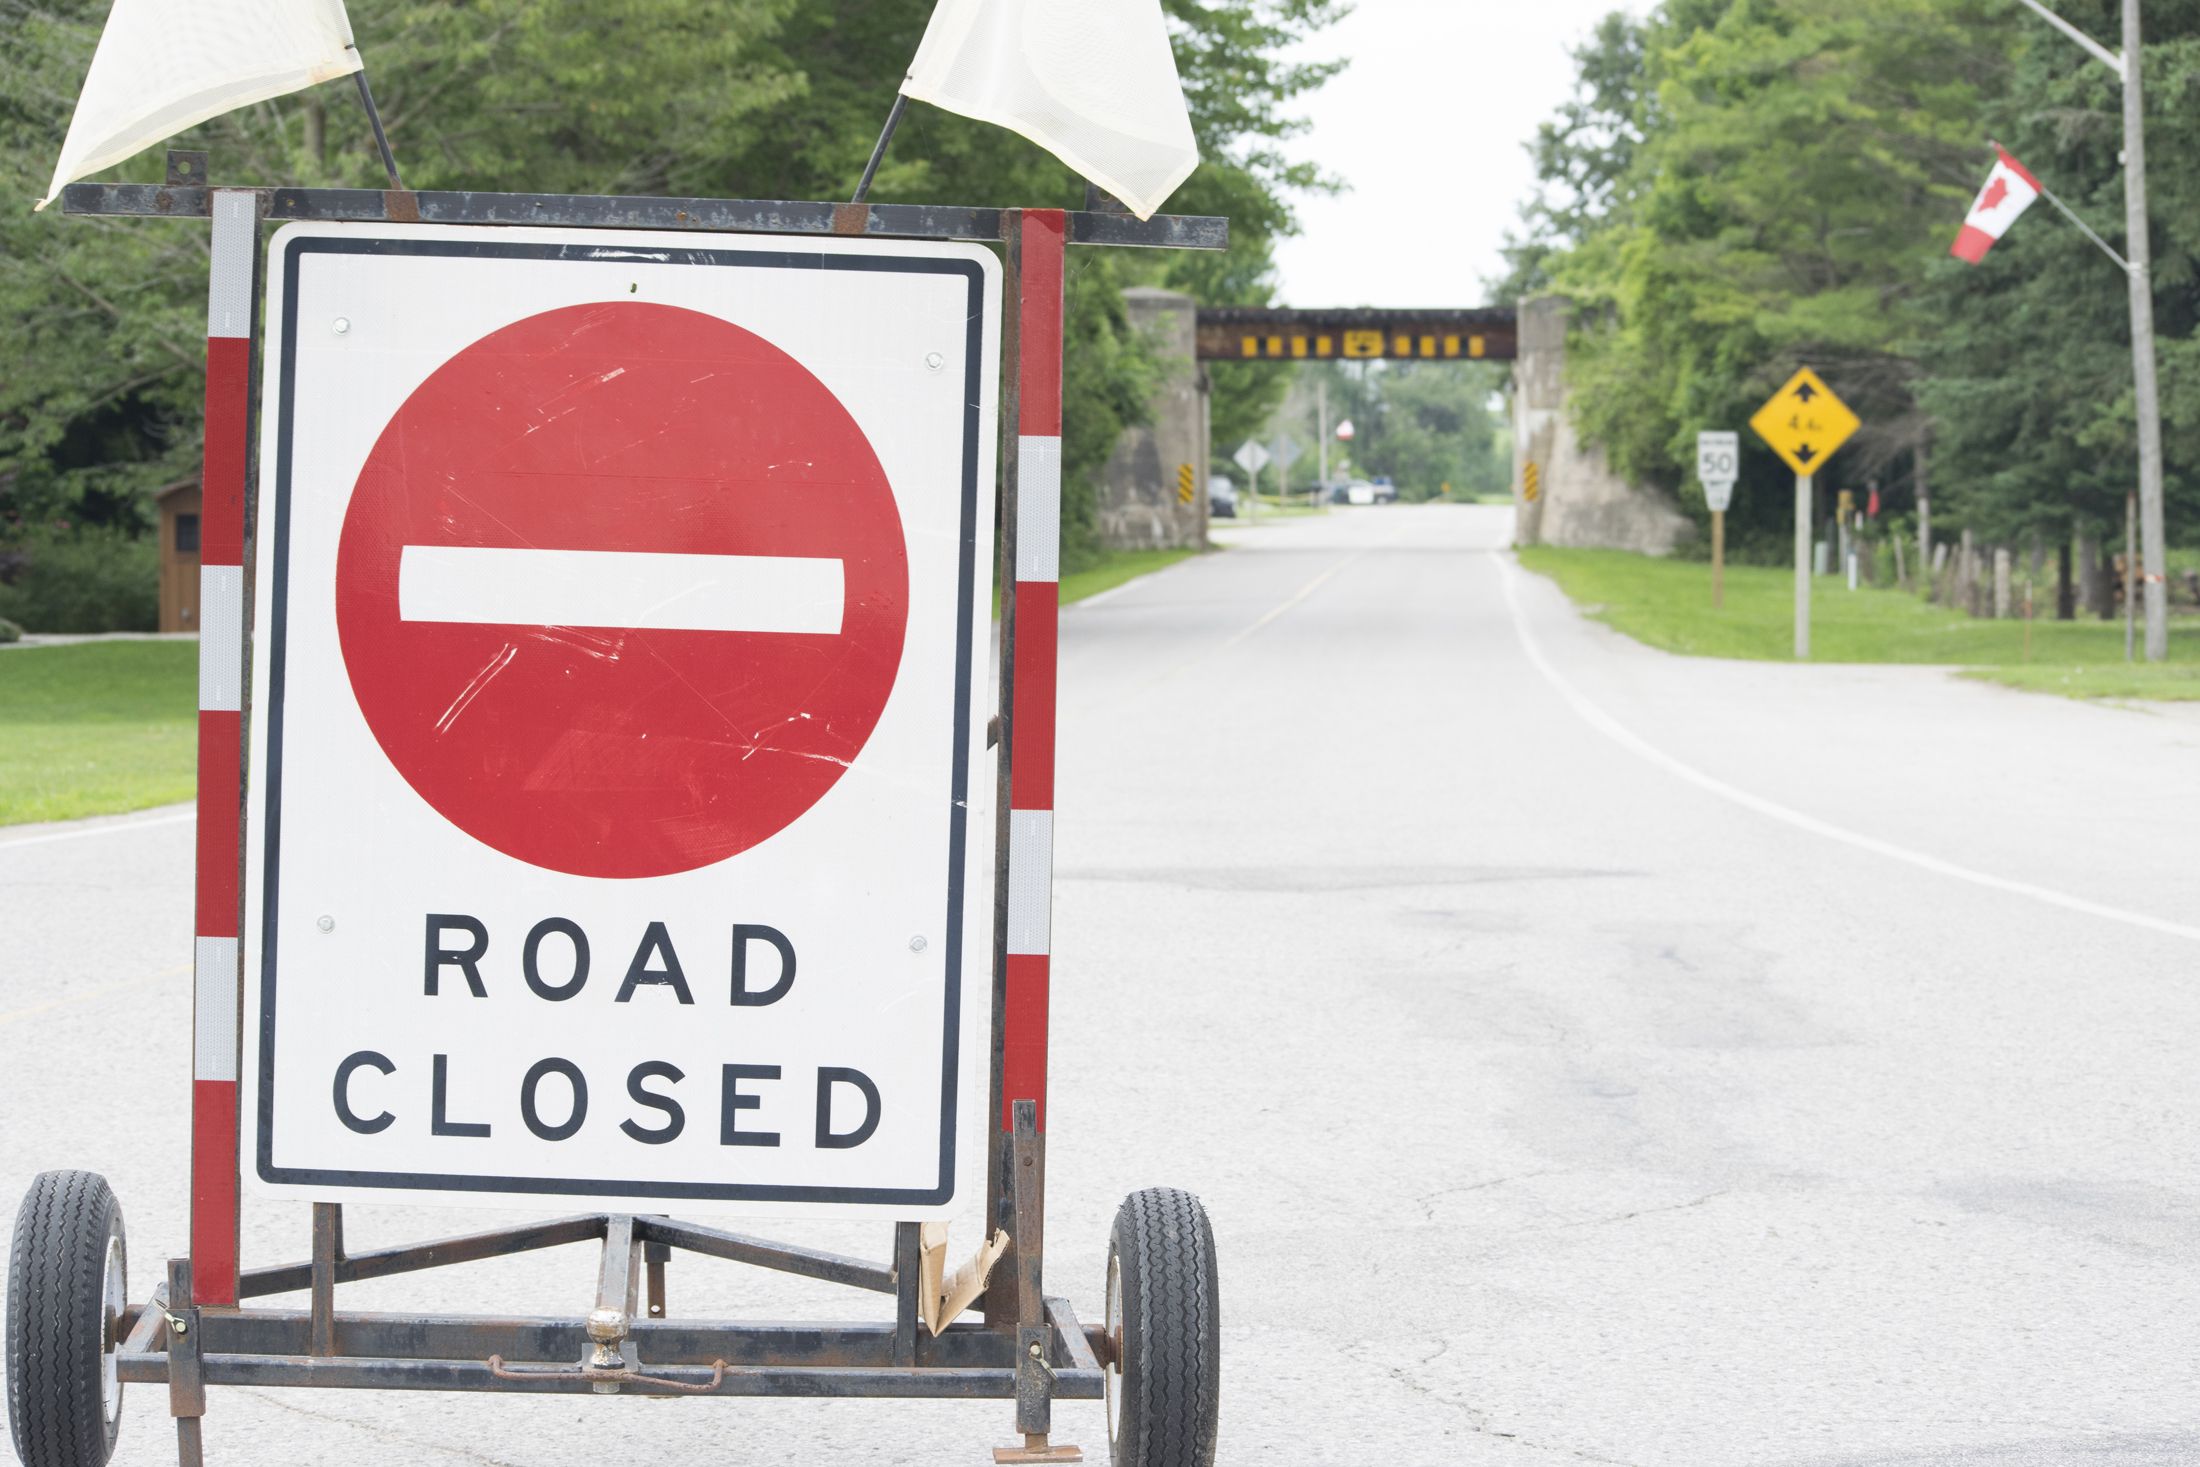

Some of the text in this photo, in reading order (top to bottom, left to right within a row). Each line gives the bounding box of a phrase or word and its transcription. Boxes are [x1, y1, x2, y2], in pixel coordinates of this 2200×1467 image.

[1703, 451, 1732, 474] 50
[424, 914, 797, 1007] ROAD
[333, 1051, 882, 1149] CLOSED
